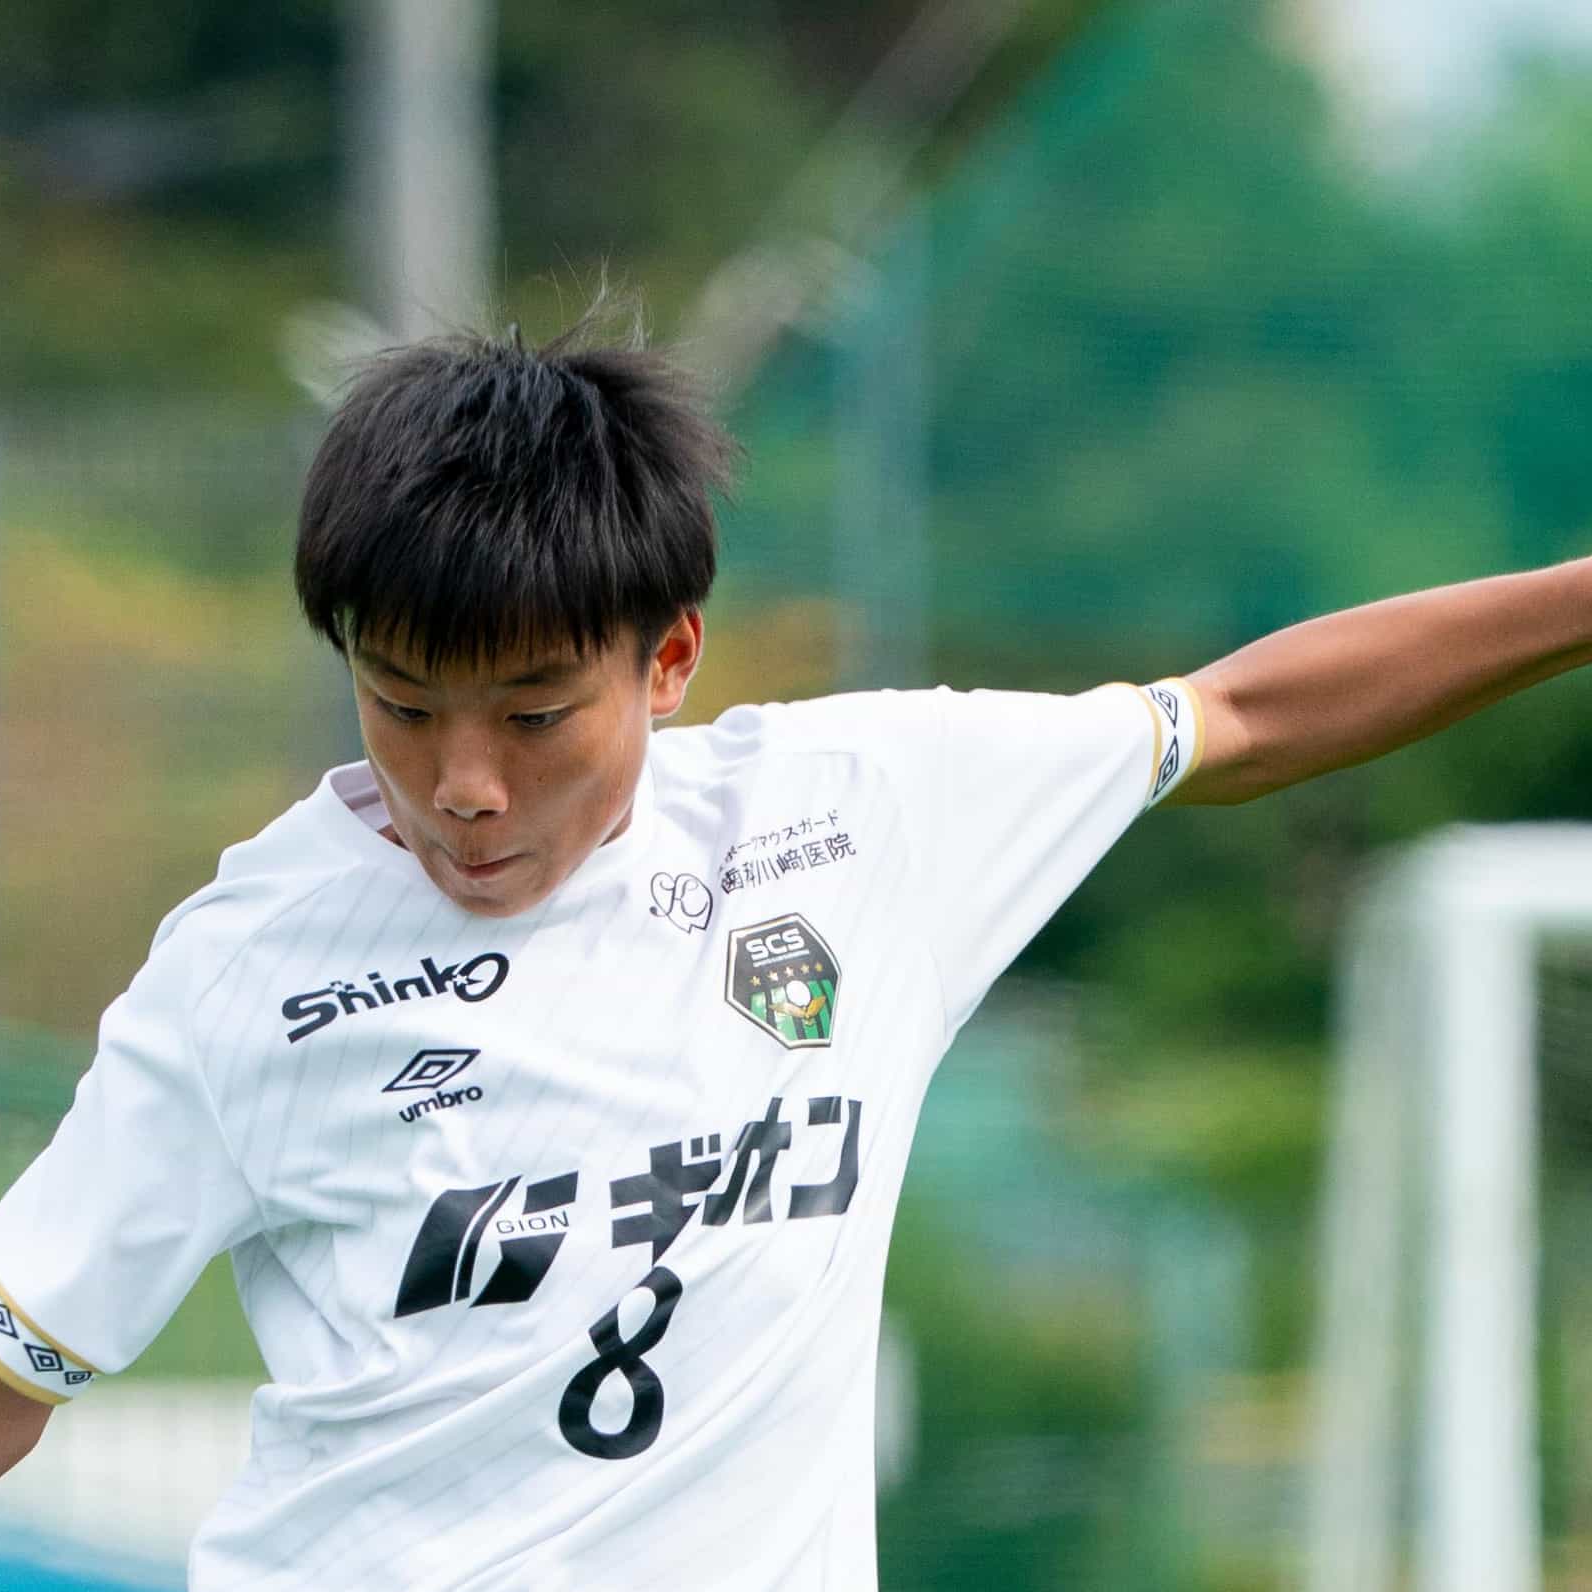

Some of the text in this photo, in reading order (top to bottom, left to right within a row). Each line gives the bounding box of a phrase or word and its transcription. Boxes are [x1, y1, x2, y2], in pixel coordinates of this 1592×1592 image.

[745, 928, 805, 961] SCS
[399, 1086, 483, 1123] umbro
[609, 1096, 862, 1268] ギオン
[495, 1210, 570, 1235] GION
[558, 1266, 683, 1460] 8
